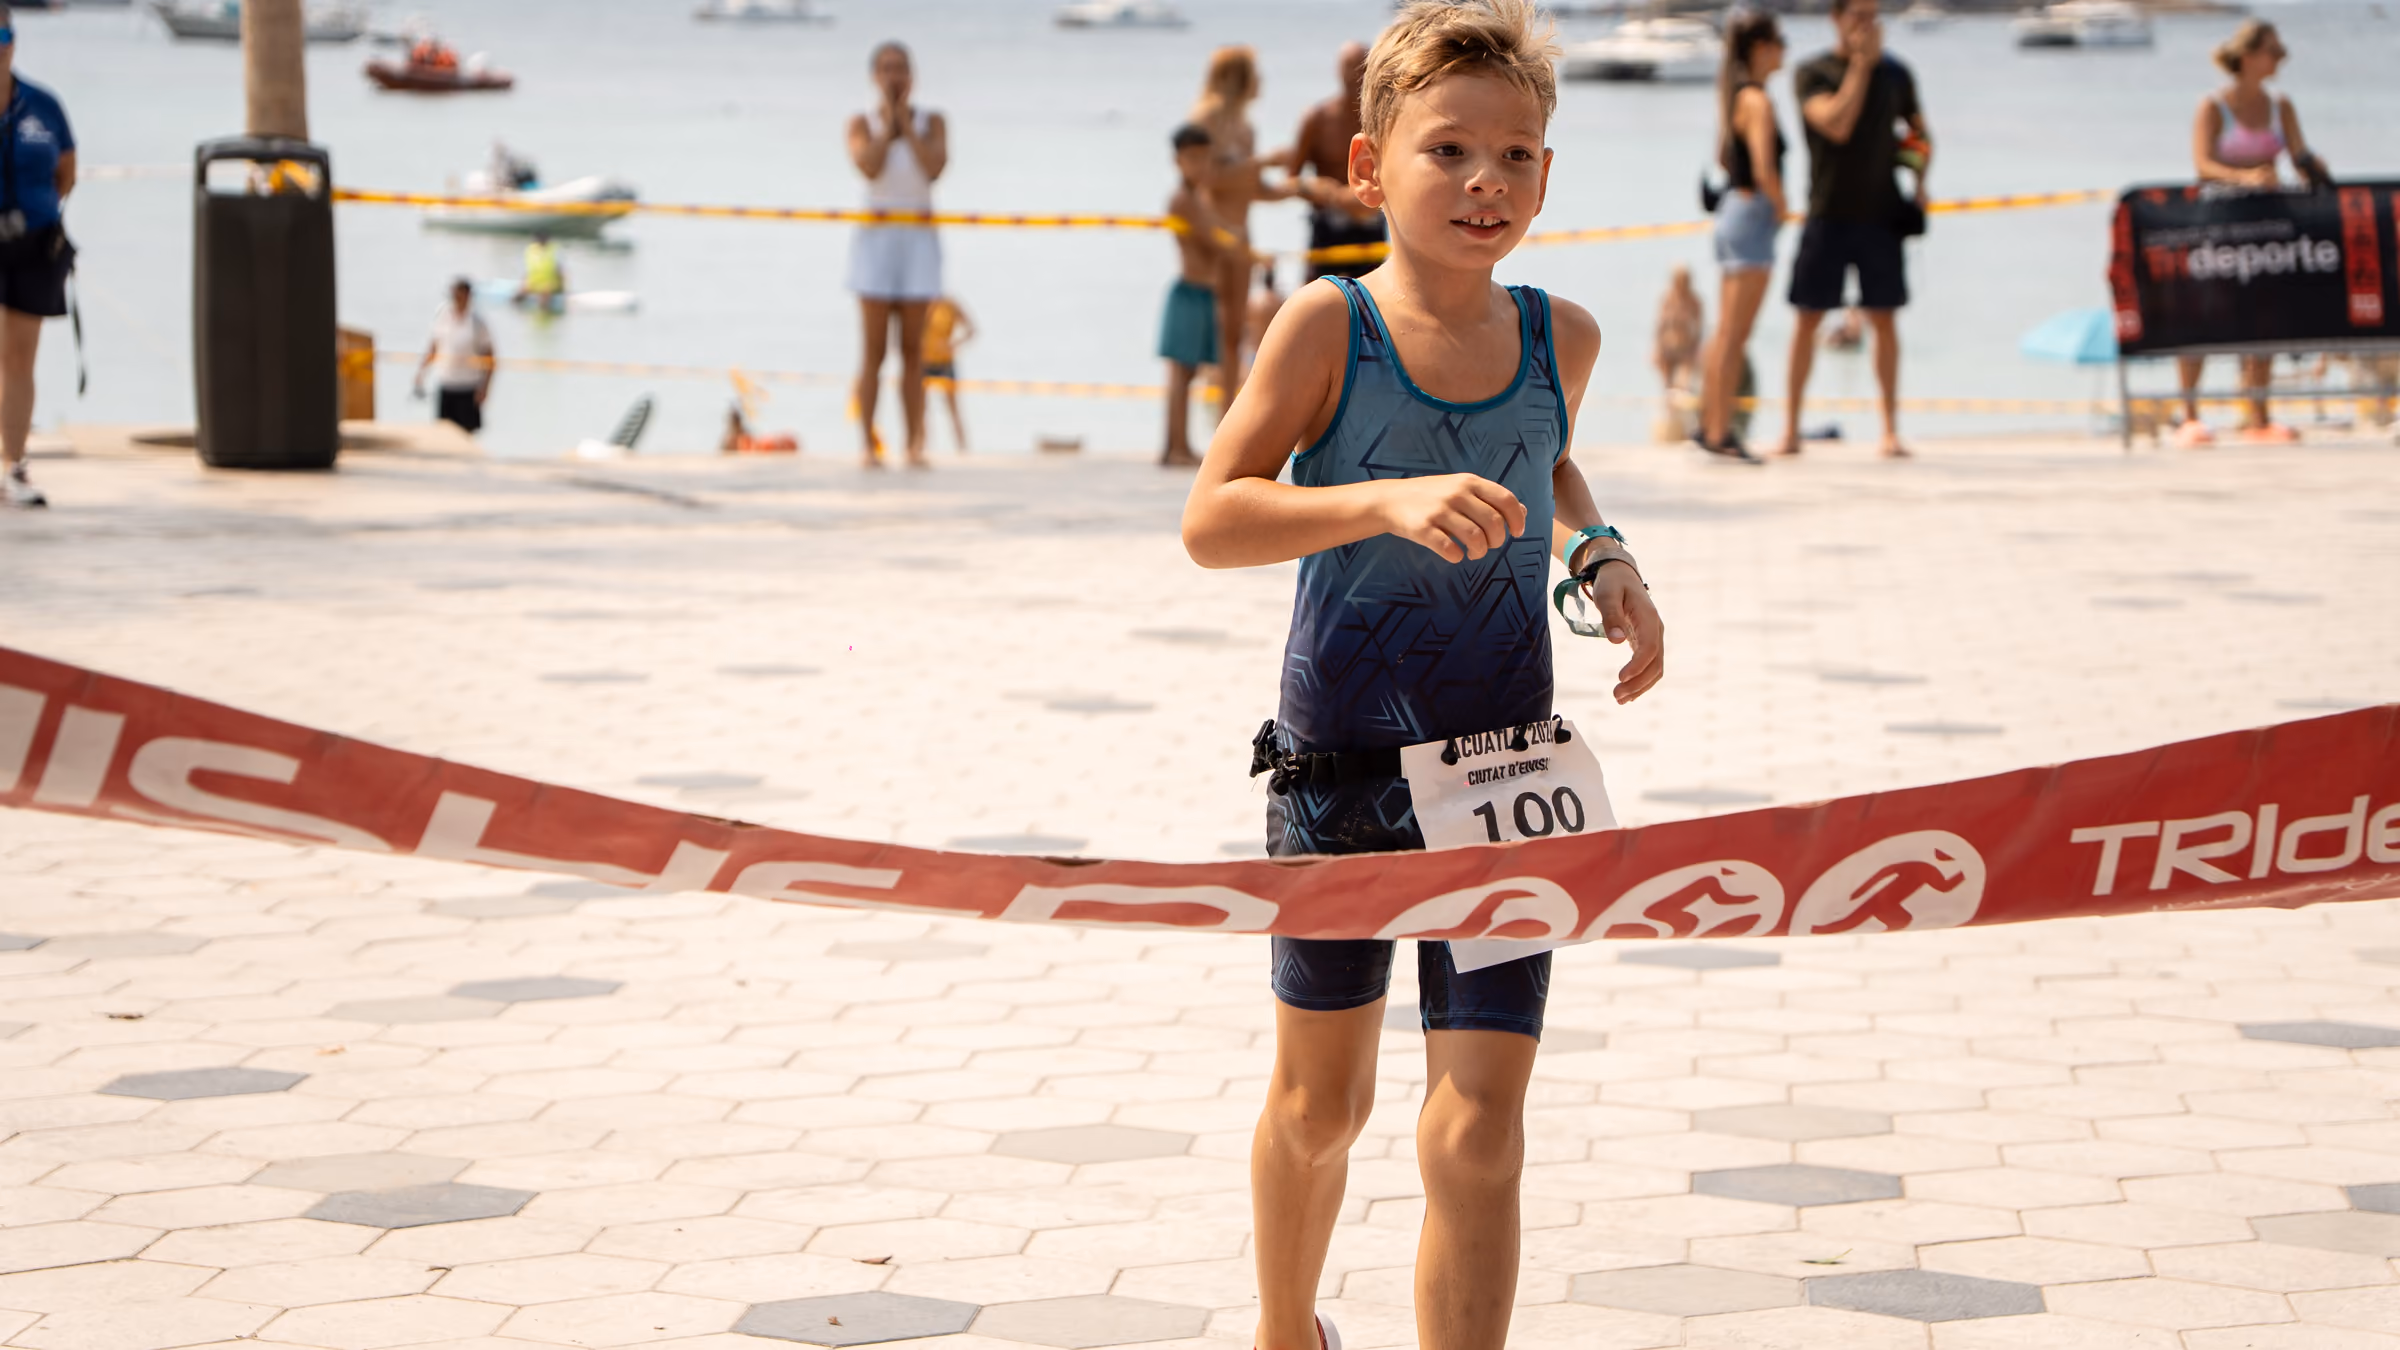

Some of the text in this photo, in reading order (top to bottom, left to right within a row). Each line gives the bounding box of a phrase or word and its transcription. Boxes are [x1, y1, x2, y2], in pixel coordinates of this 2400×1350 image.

[1527, 721, 1555, 746] 202
[1467, 765, 1506, 786] CIUTAT
[1473, 787, 1585, 843] 100
